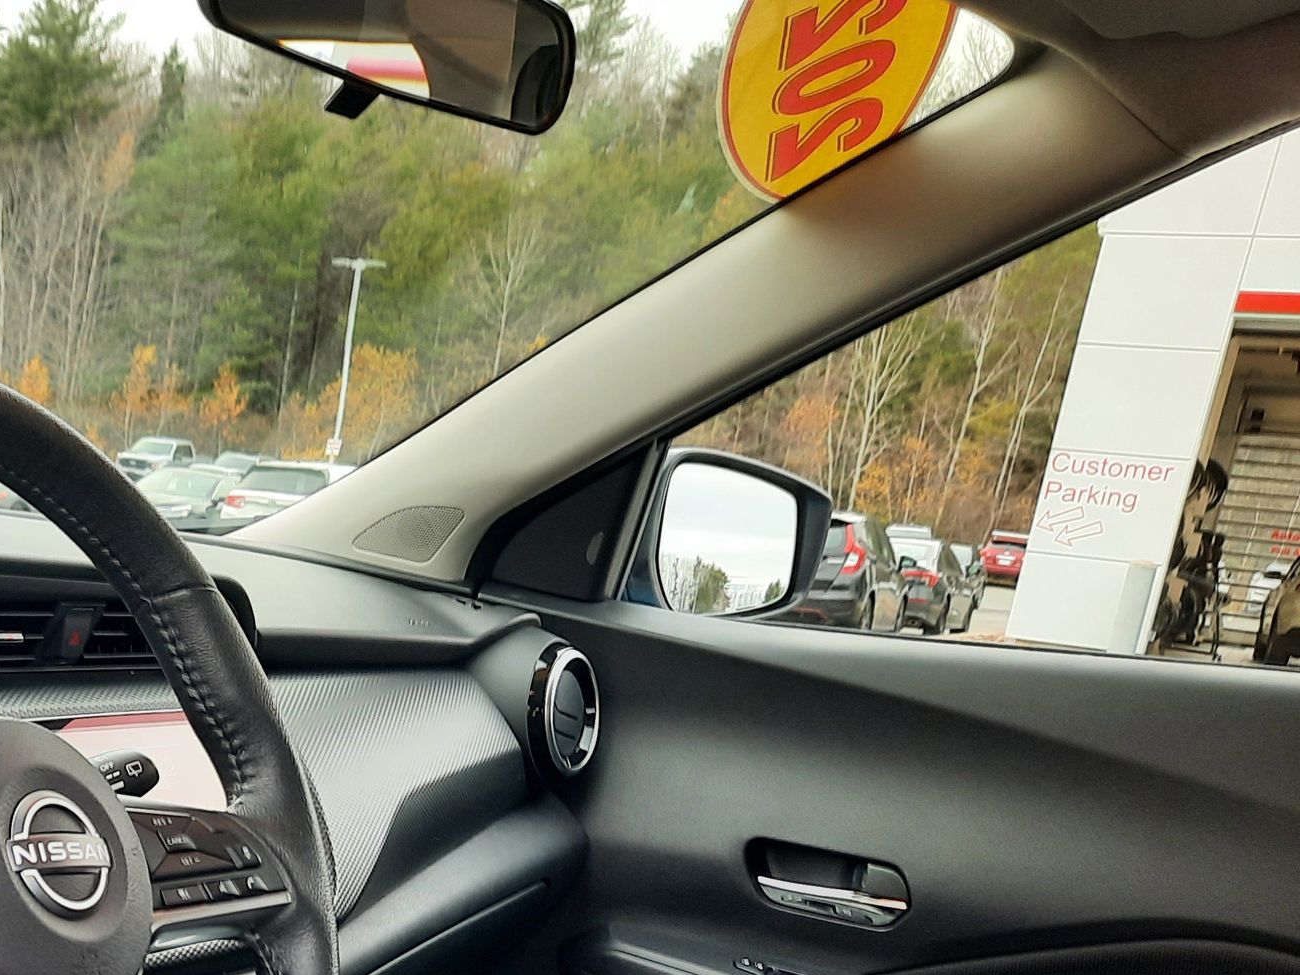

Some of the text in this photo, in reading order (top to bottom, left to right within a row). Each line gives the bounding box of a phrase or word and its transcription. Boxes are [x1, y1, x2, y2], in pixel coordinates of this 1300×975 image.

[1051, 452, 1175, 482] Customer
[1043, 480, 1139, 513] Parking
[12, 841, 111, 866] NISSAN
